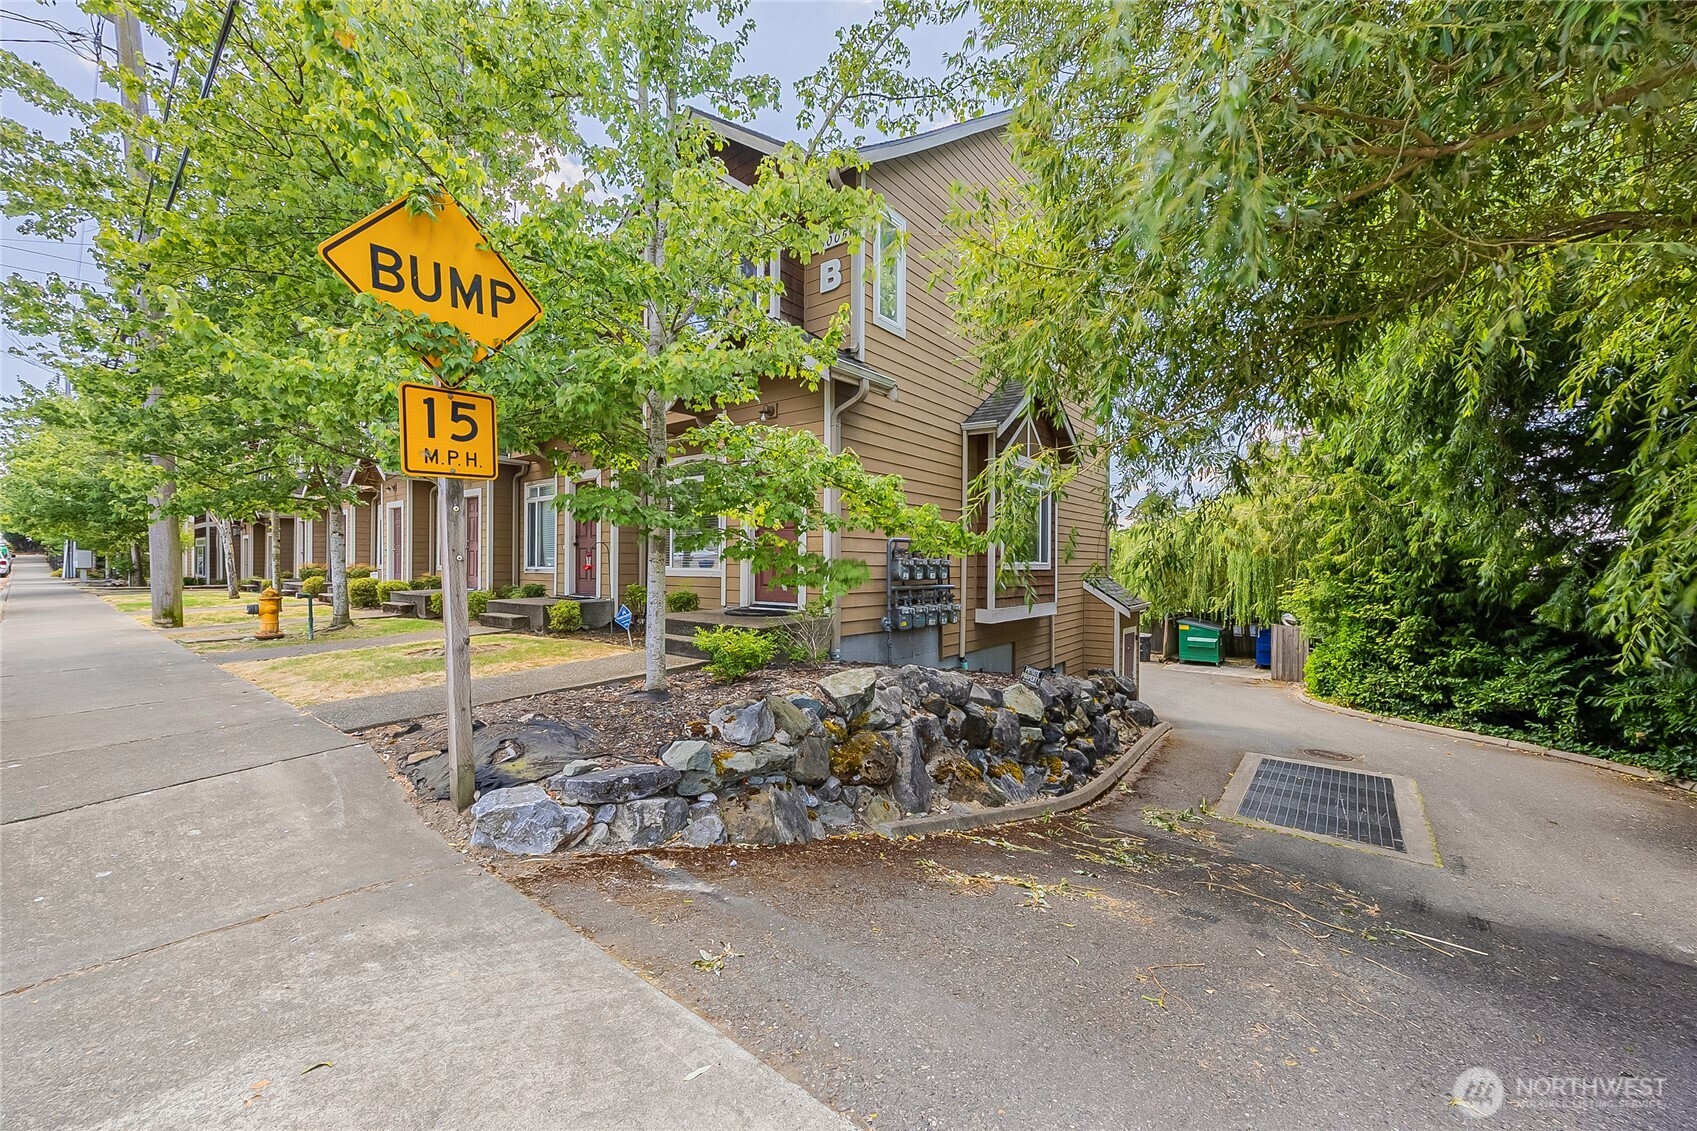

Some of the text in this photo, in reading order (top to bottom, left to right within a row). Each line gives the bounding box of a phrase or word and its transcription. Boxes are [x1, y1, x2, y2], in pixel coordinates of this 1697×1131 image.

[370, 243, 516, 318] BUMP
[820, 258, 842, 295] B
[423, 397, 478, 442] 15
[424, 448, 482, 468] M.P.H.
